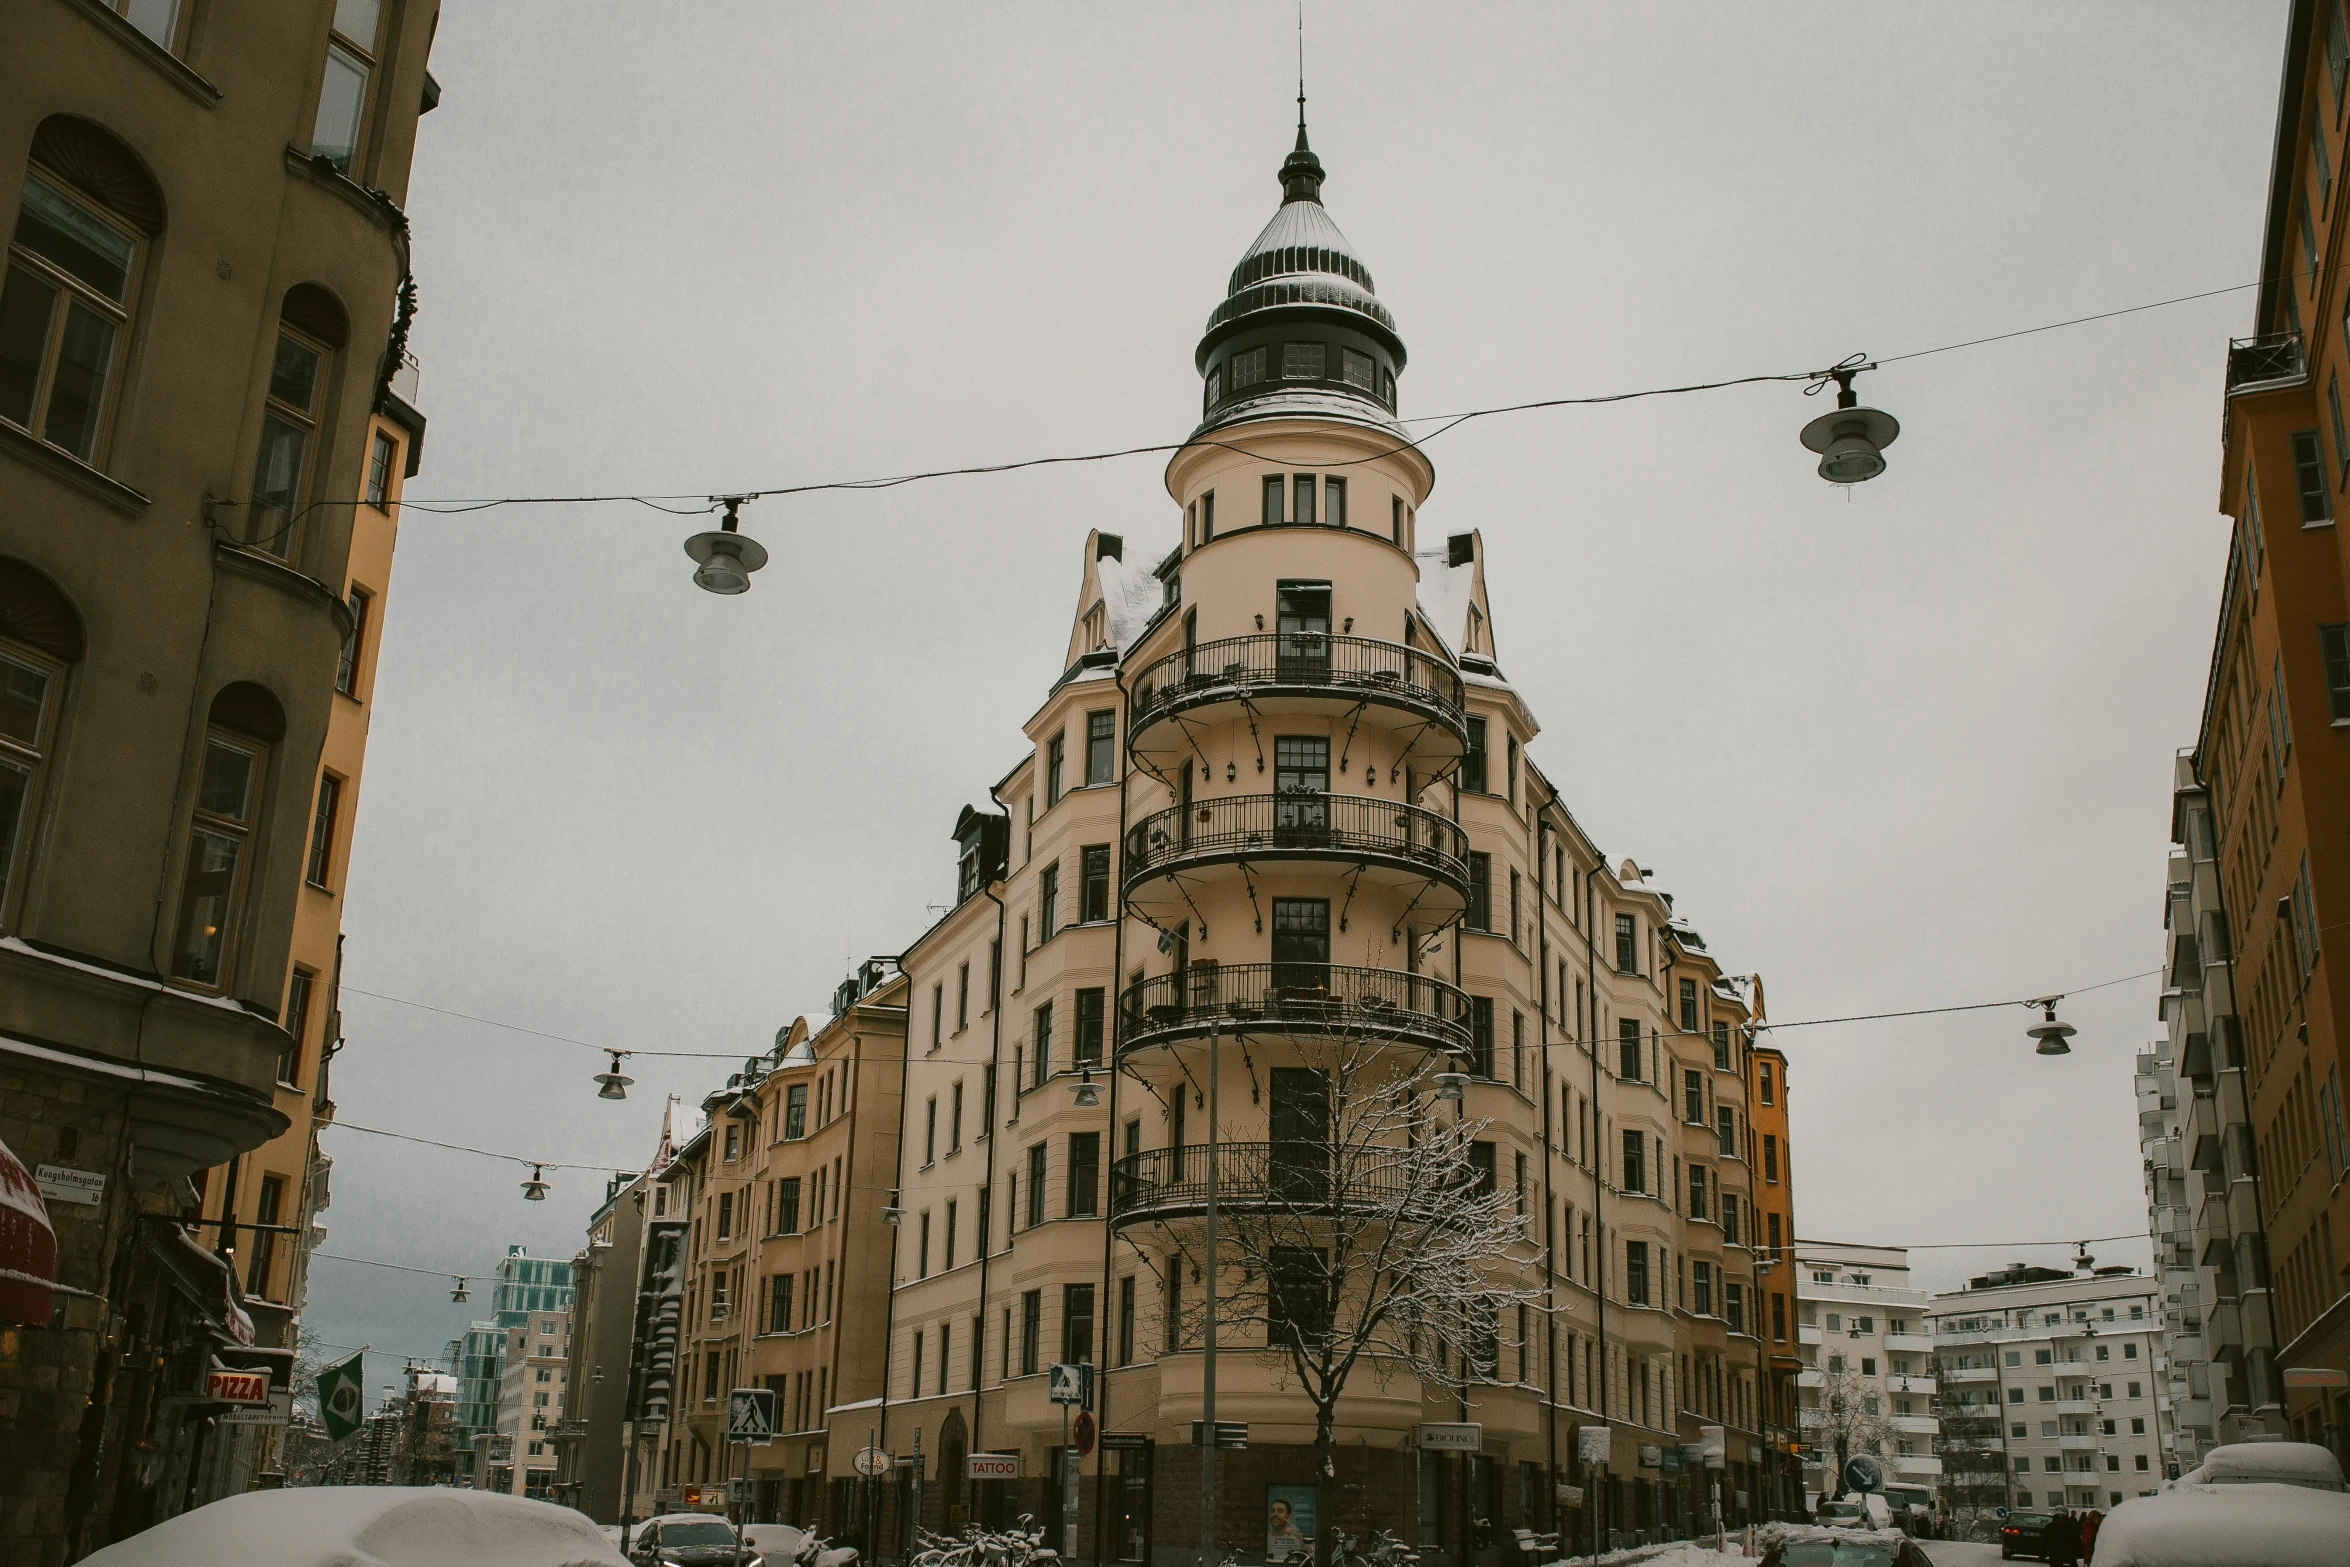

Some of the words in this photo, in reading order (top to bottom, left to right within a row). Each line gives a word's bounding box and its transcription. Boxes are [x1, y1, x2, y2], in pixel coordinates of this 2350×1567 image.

[38, 1167, 104, 1187] Kungsholmsgatan
[91, 1192, 100, 1203] 16
[205, 1375, 264, 1401] PIZZA
[860, 1462, 884, 1470] Fond
[972, 1462, 1016, 1474] TATTOO
